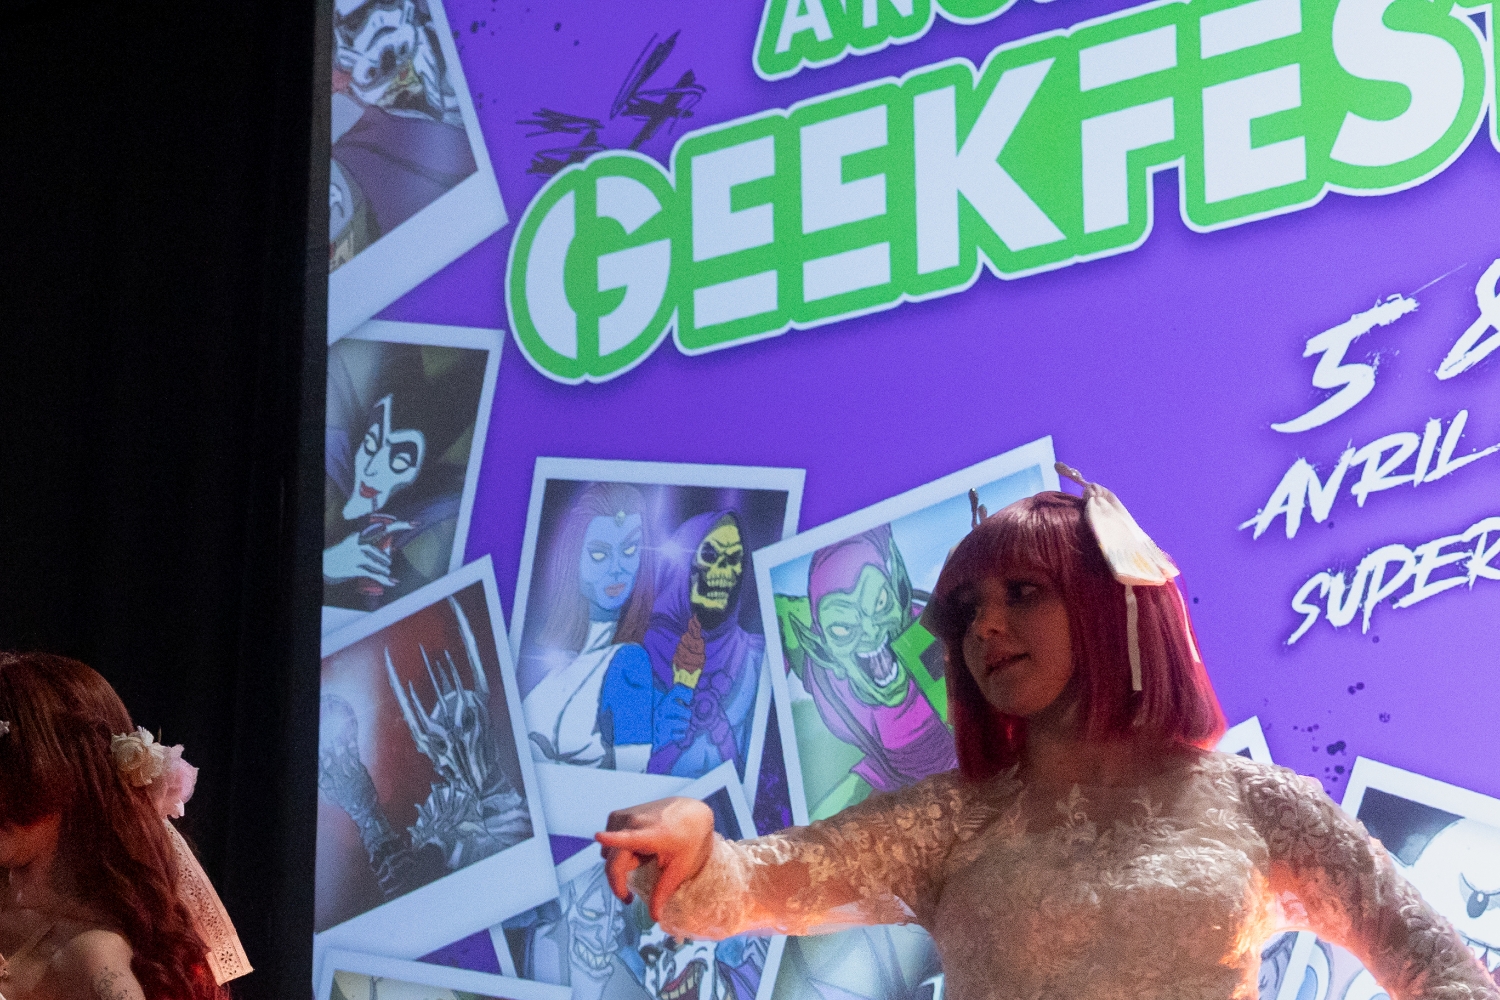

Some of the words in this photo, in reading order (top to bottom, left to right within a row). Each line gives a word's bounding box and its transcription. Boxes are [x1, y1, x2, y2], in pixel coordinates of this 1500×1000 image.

[508, 0, 1500, 380] GEEKFES
[1271, 294, 1419, 433] 5
[1237, 409, 1500, 540] AVRIL
